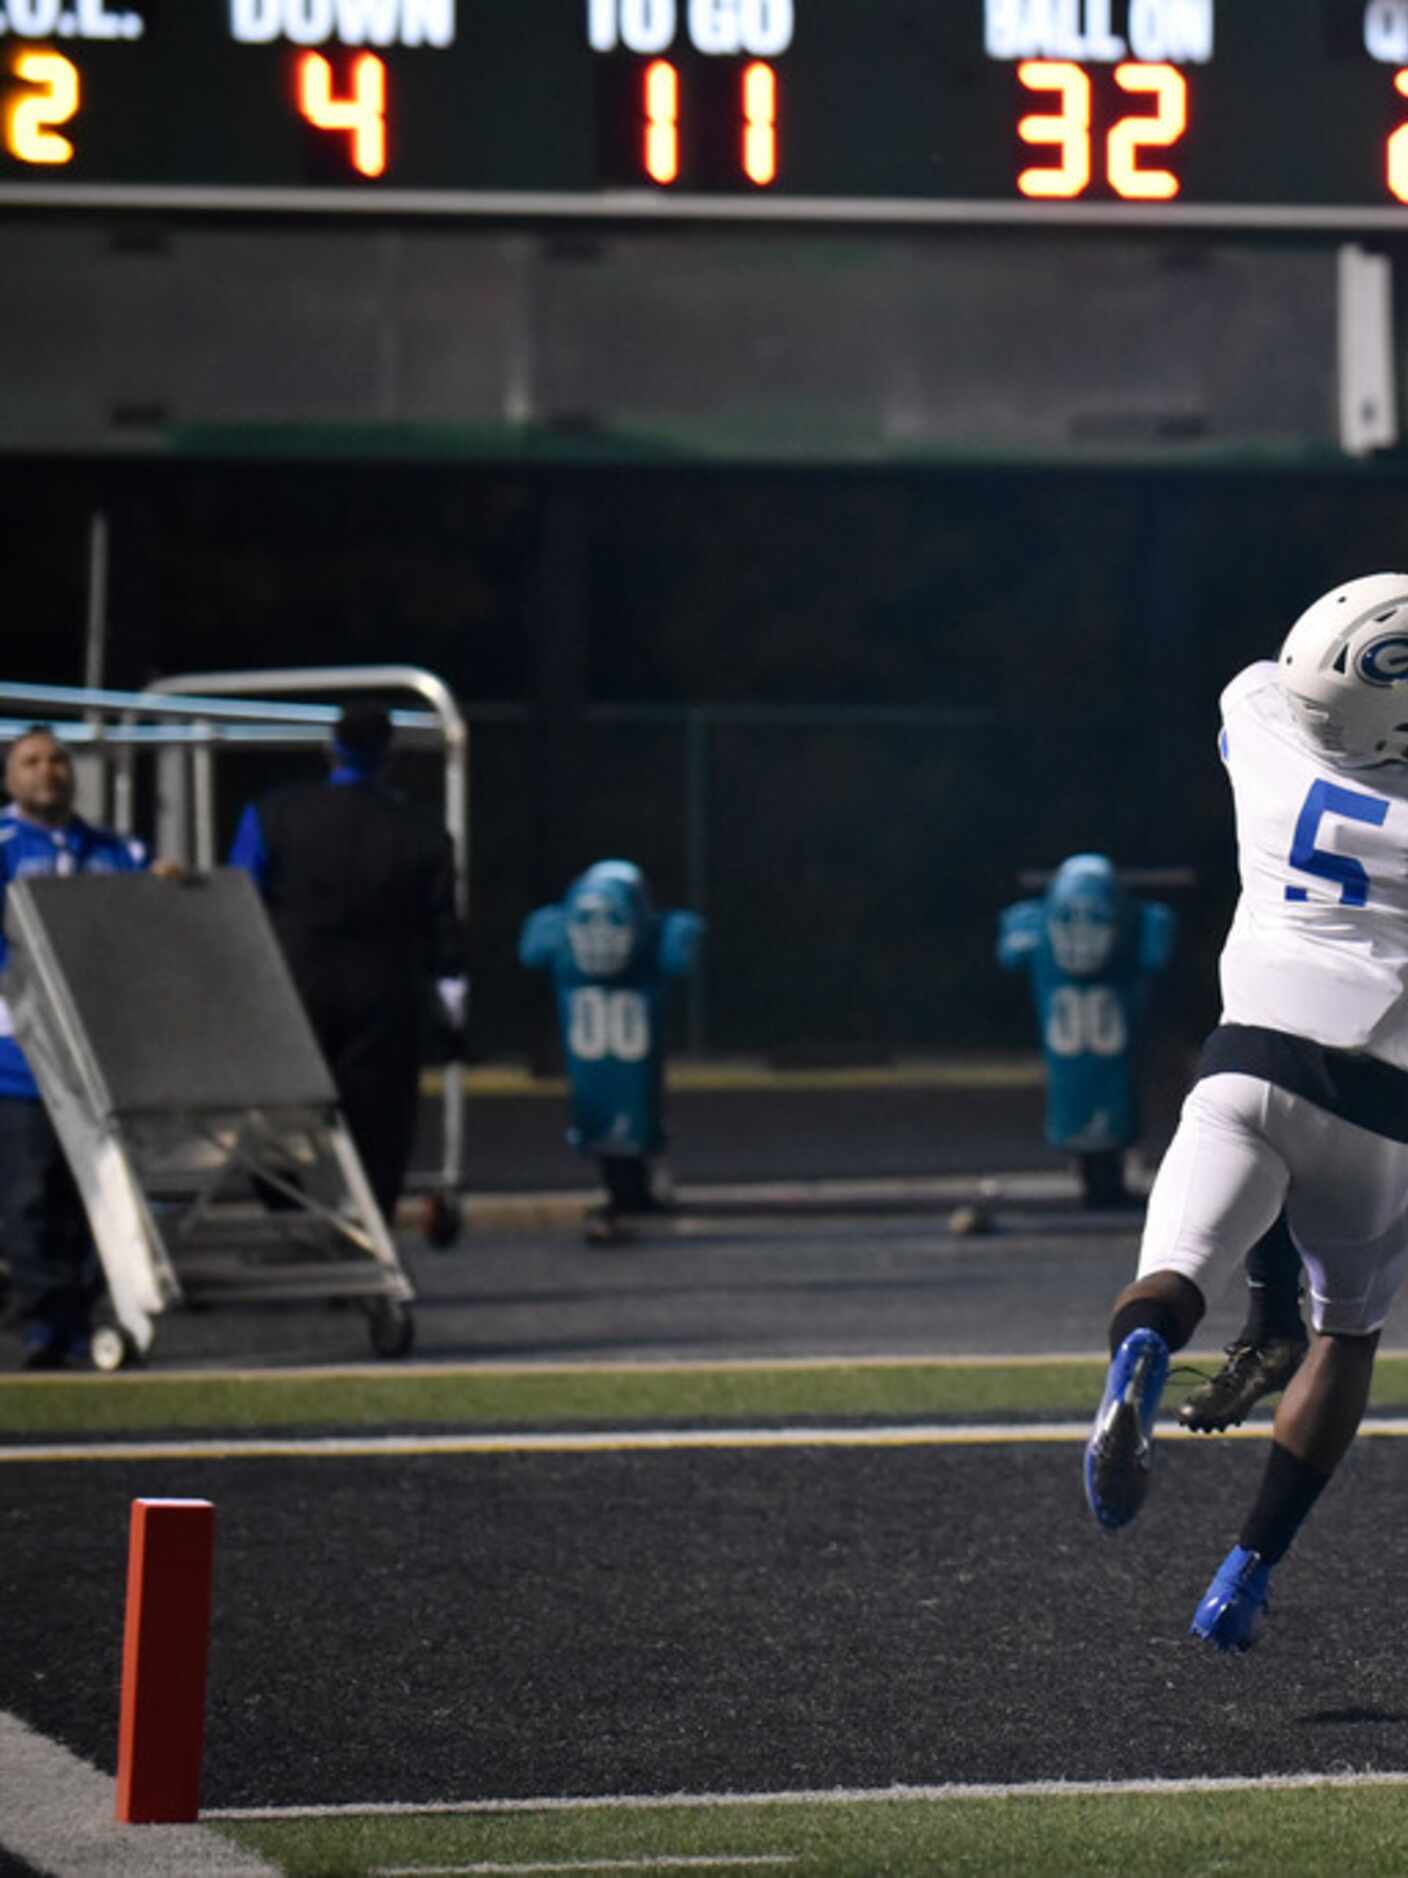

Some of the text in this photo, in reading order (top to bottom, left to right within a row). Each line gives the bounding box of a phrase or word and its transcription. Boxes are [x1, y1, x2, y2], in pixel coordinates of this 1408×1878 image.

[230, 0, 455, 47] DOWN
[687, 0, 794, 56] GO
[984, 0, 1213, 64] BALL ON
[8, 49, 80, 164] 2
[298, 48, 386, 179] 4
[643, 57, 777, 186] 11
[1016, 58, 1187, 200] 32
[1284, 778, 1390, 907] 5
[568, 985, 650, 1060] 00
[1045, 985, 1128, 1056] 00
